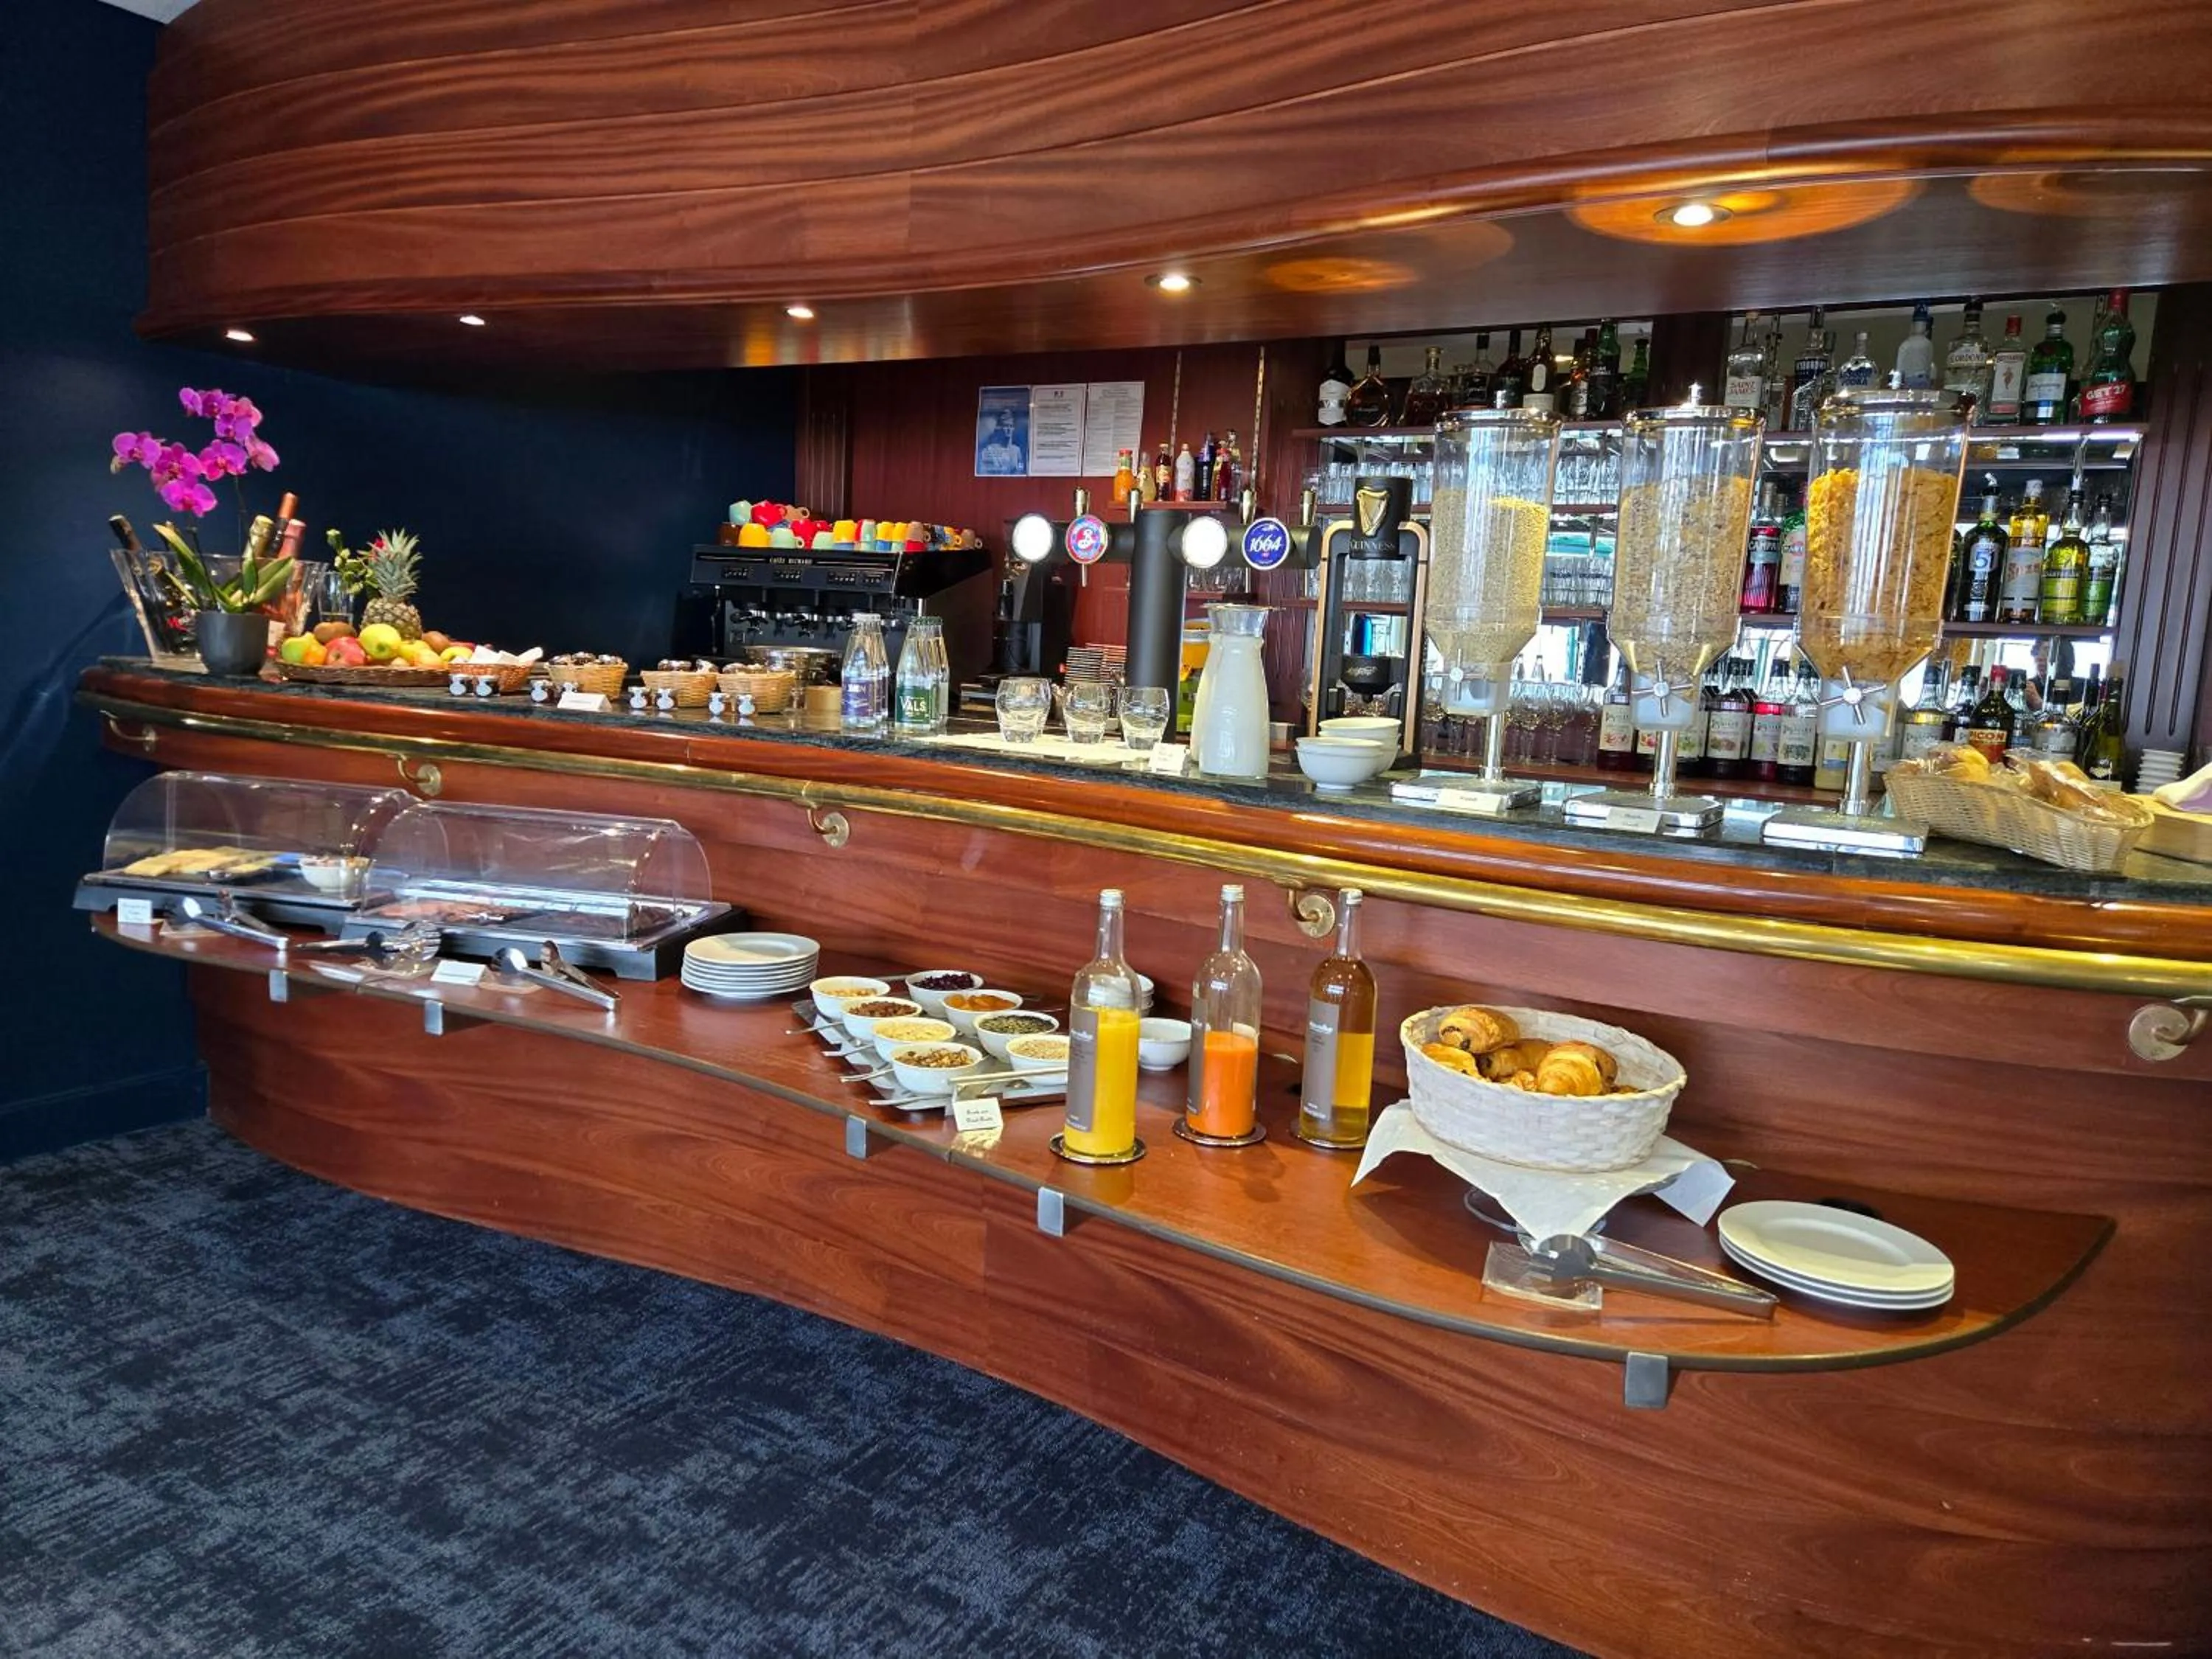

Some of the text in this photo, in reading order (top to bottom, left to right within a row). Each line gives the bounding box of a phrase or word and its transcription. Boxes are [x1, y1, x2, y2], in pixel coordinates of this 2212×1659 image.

[2086, 386, 2112, 400] GET
[1250, 534, 1282, 552] 1664
[900, 695, 927, 712] VALS
